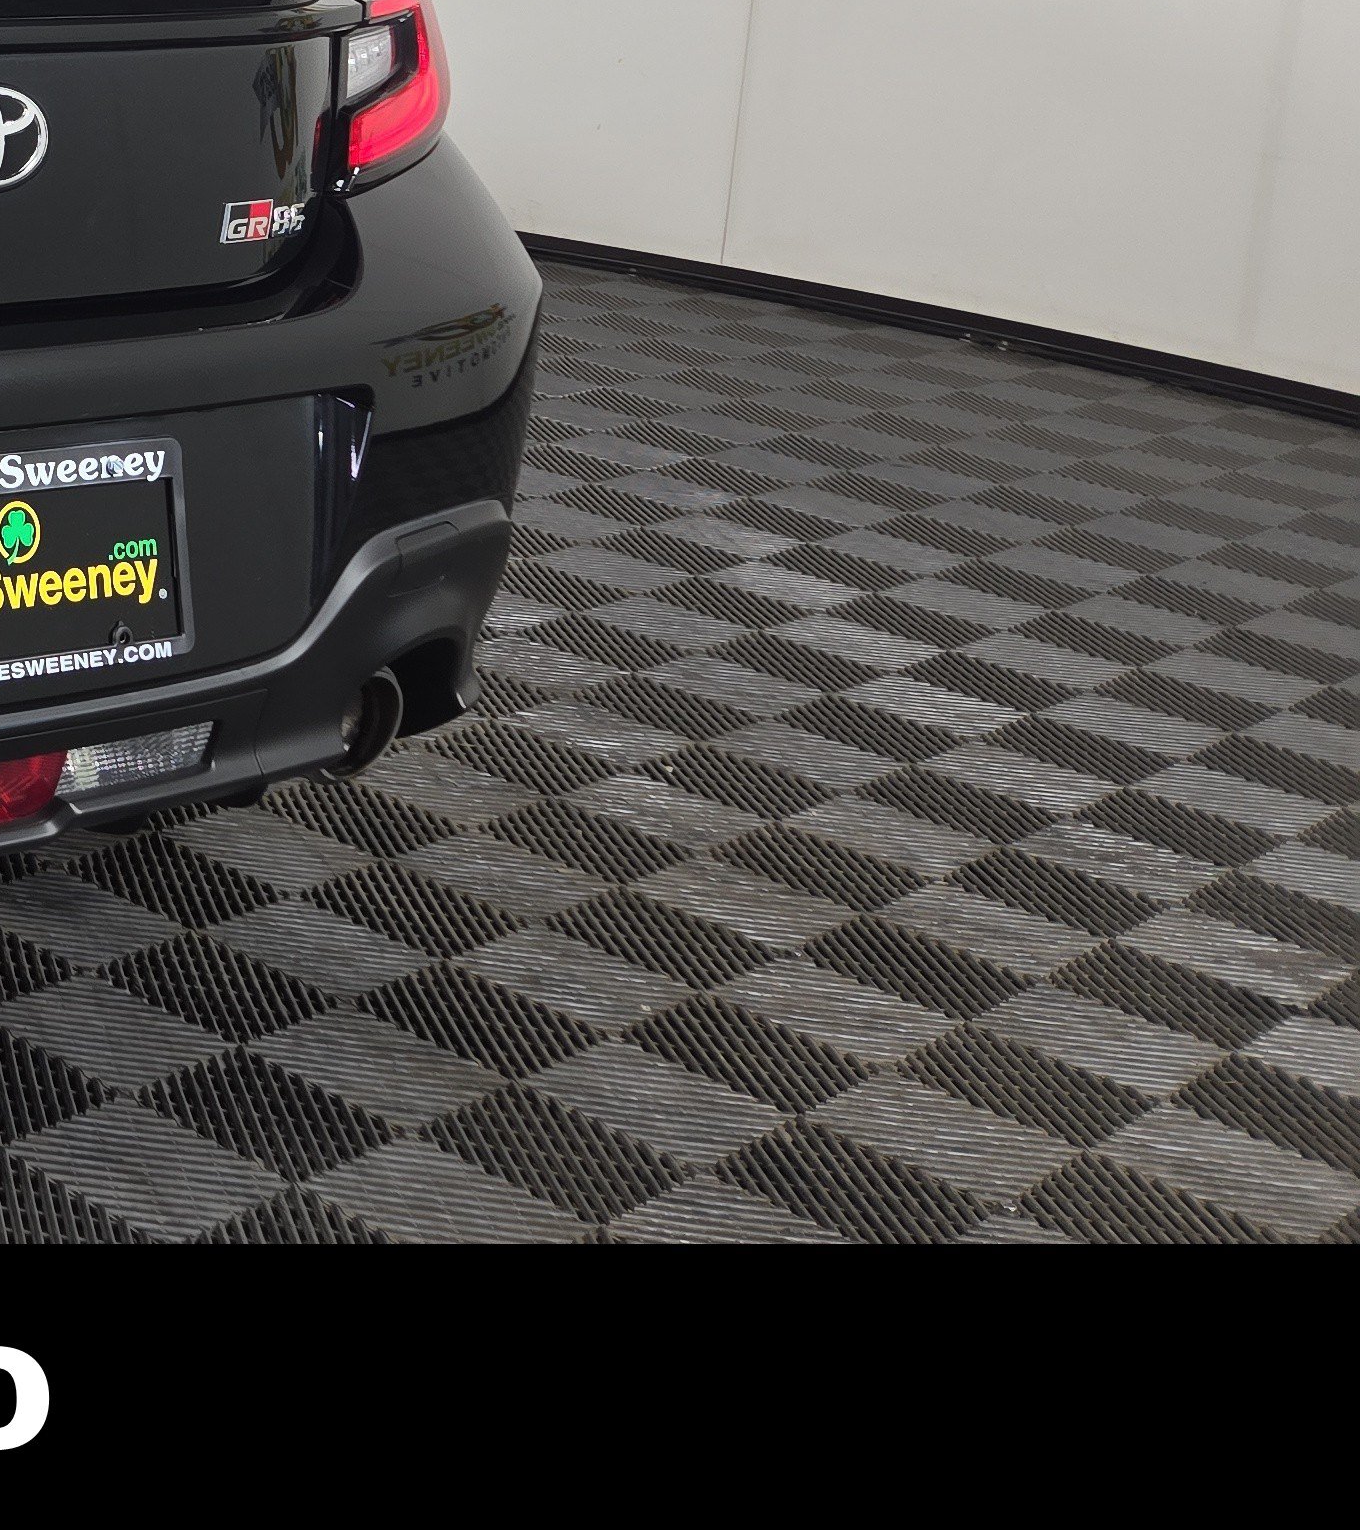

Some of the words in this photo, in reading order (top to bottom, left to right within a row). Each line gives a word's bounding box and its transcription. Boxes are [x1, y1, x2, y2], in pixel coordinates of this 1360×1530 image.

[227, 216, 269, 240] GR
[0, 450, 166, 490] Sweeney
[108, 537, 158, 561] .com
